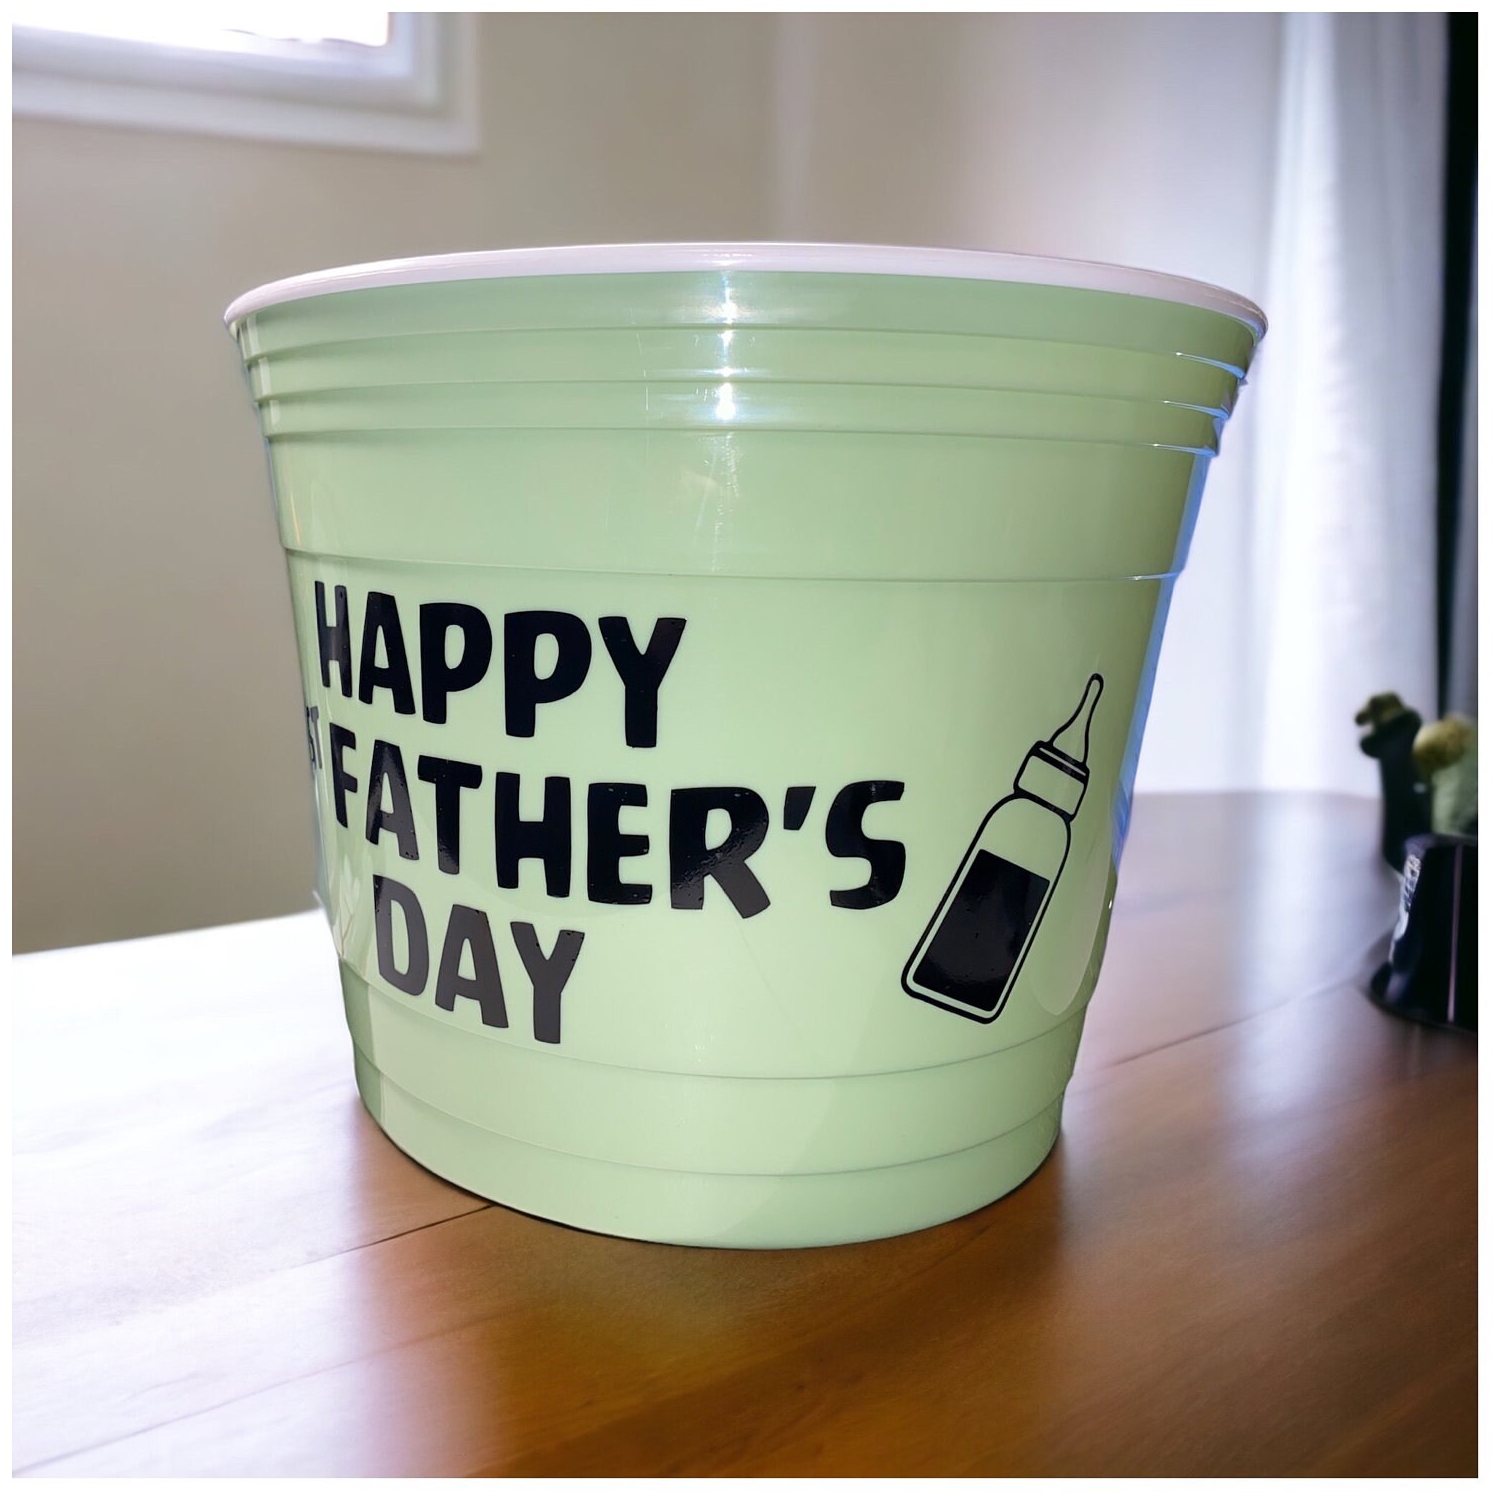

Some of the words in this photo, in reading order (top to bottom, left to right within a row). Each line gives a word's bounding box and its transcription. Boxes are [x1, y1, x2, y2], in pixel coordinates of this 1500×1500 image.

[315, 581, 687, 748] HAPPY
[329, 723, 906, 918] FATHER'S
[373, 875, 585, 1044] DAY
